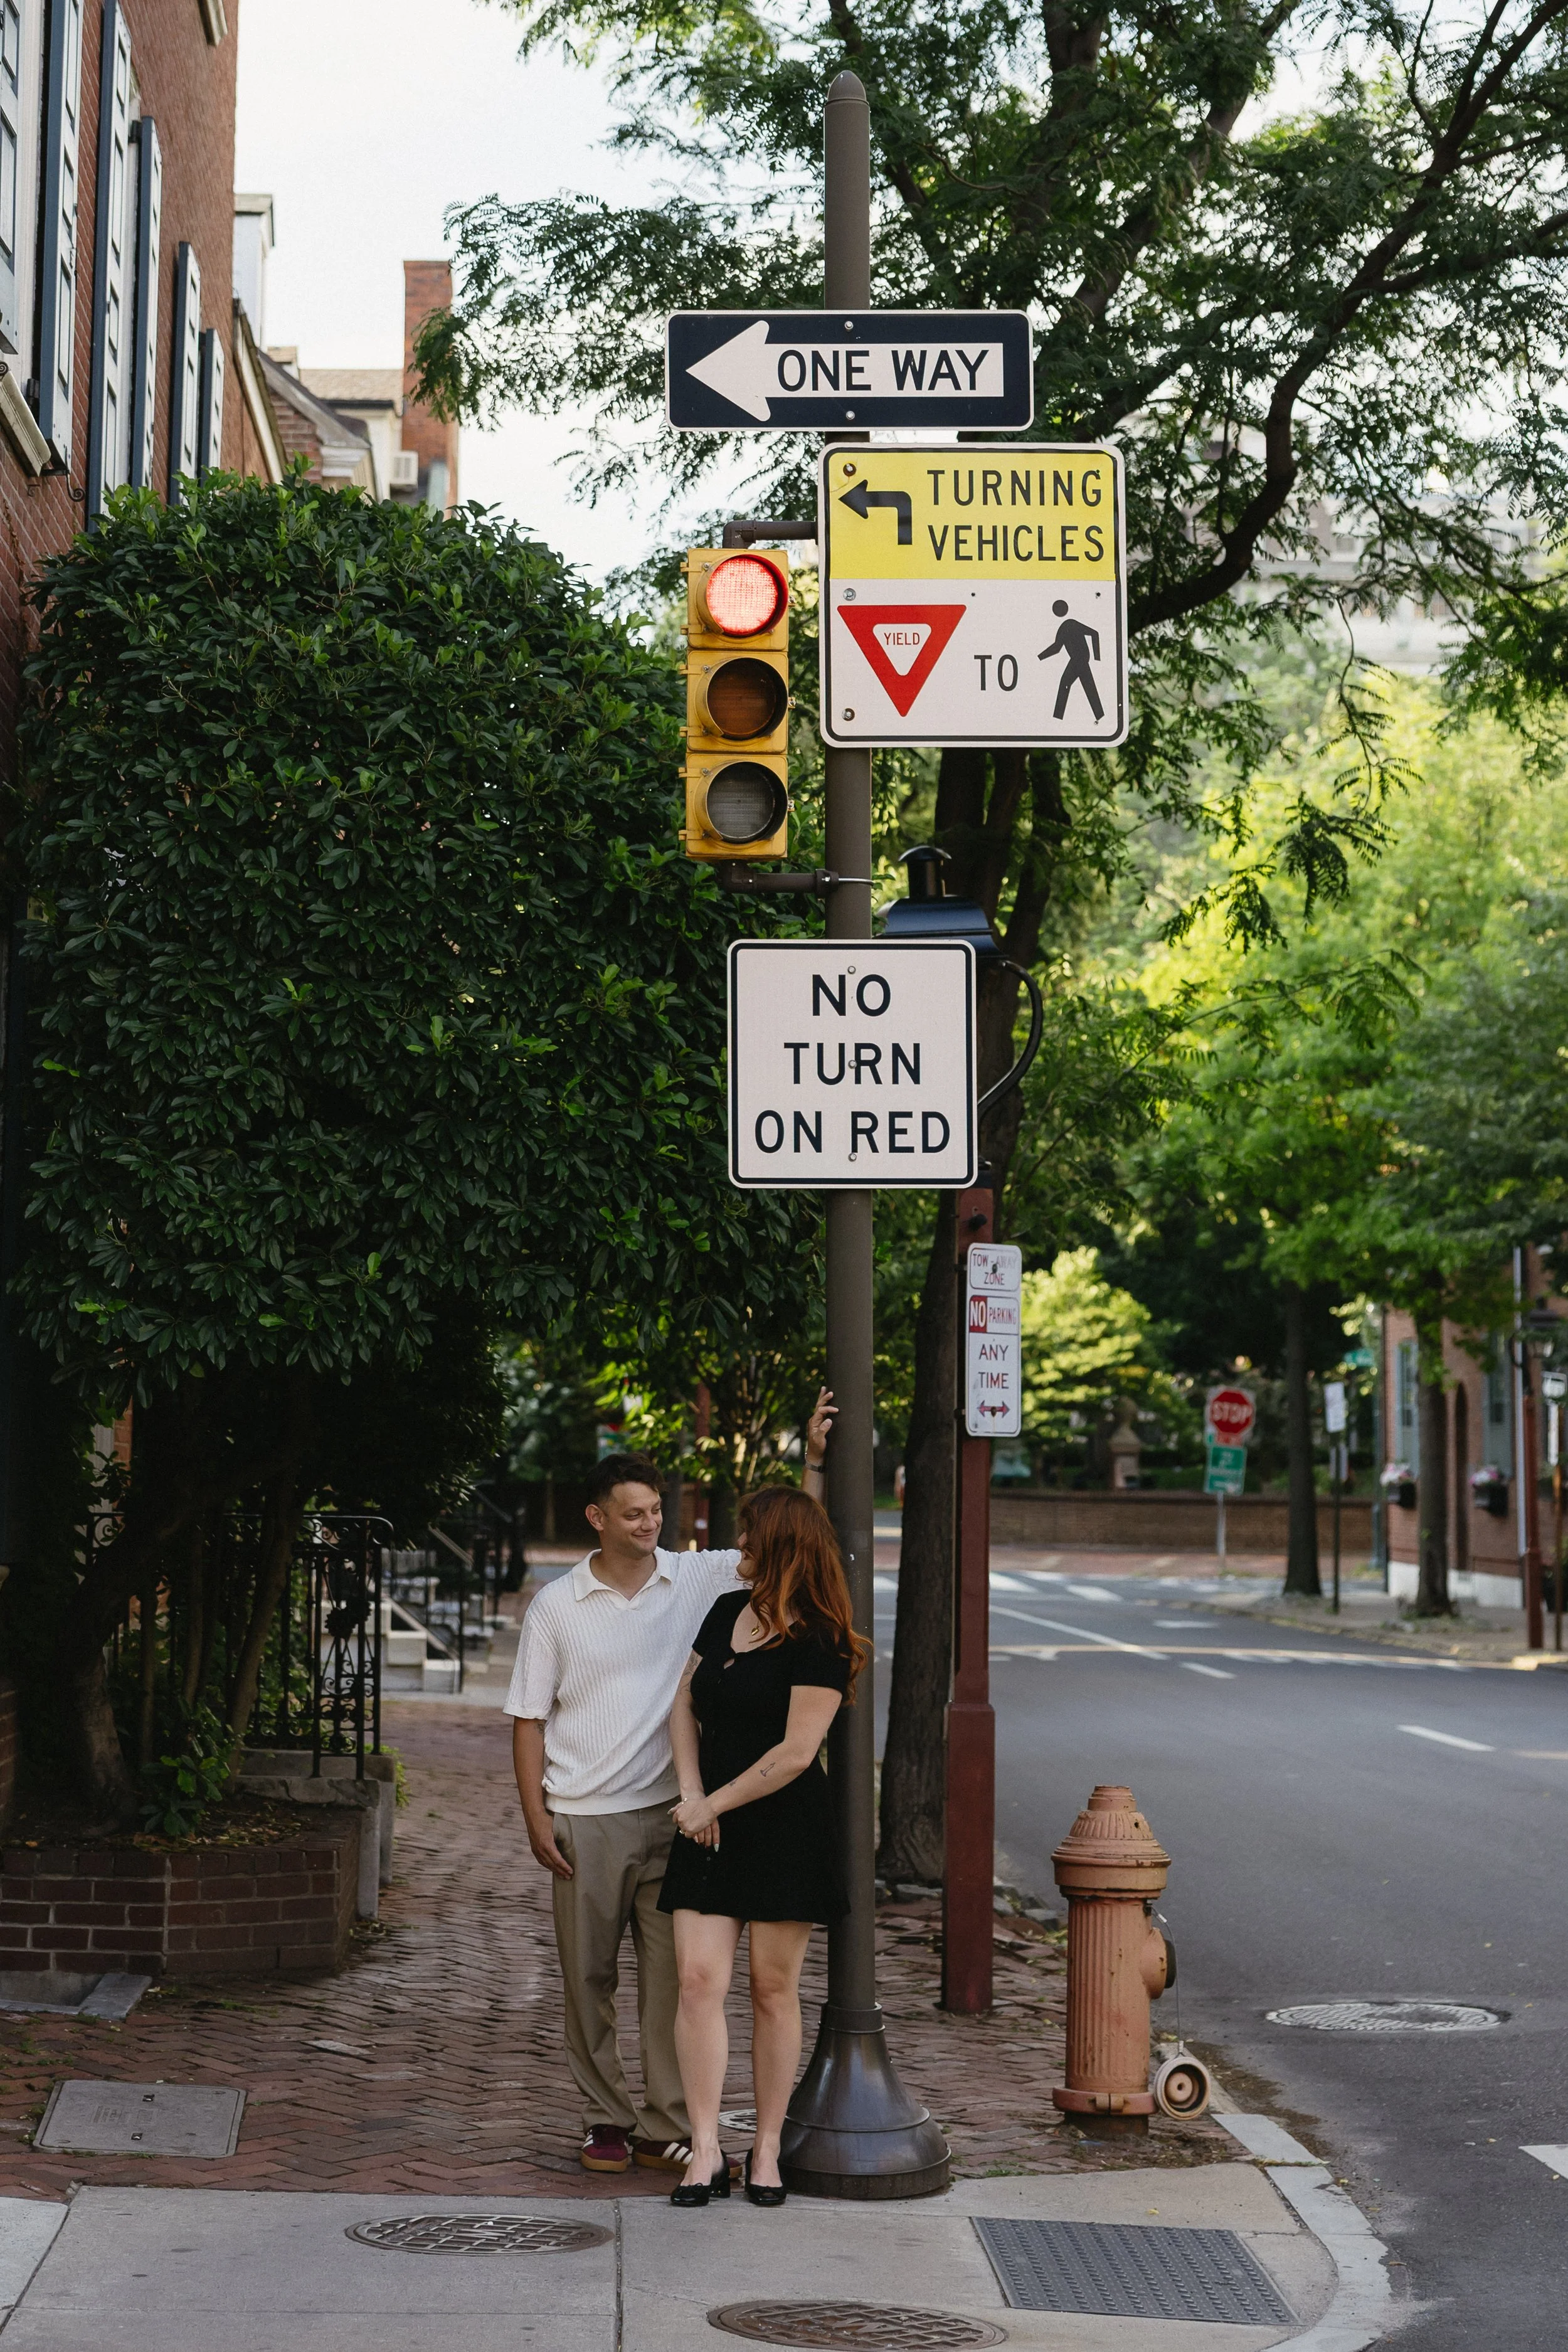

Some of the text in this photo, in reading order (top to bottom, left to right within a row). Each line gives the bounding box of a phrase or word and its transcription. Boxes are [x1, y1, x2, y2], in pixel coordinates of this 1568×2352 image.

[777, 349, 989, 392] ONE WAY
[927, 469, 1103, 507] TURNING
[928, 525, 1104, 562] VEHICLES
[883, 632, 921, 647] YIELD
[973, 655, 1019, 692] TO
[812, 973, 891, 1017] NO
[784, 1042, 921, 1085] TURN
[755, 1110, 950, 1153] ON RED
[983, 1273, 1005, 1285] ZONE
[970, 1300, 1017, 1327] NO PARKING
[978, 1343, 1009, 1361] ANY
[978, 1372, 1009, 1389] TIME
[1212, 1401, 1253, 1425] STOP
